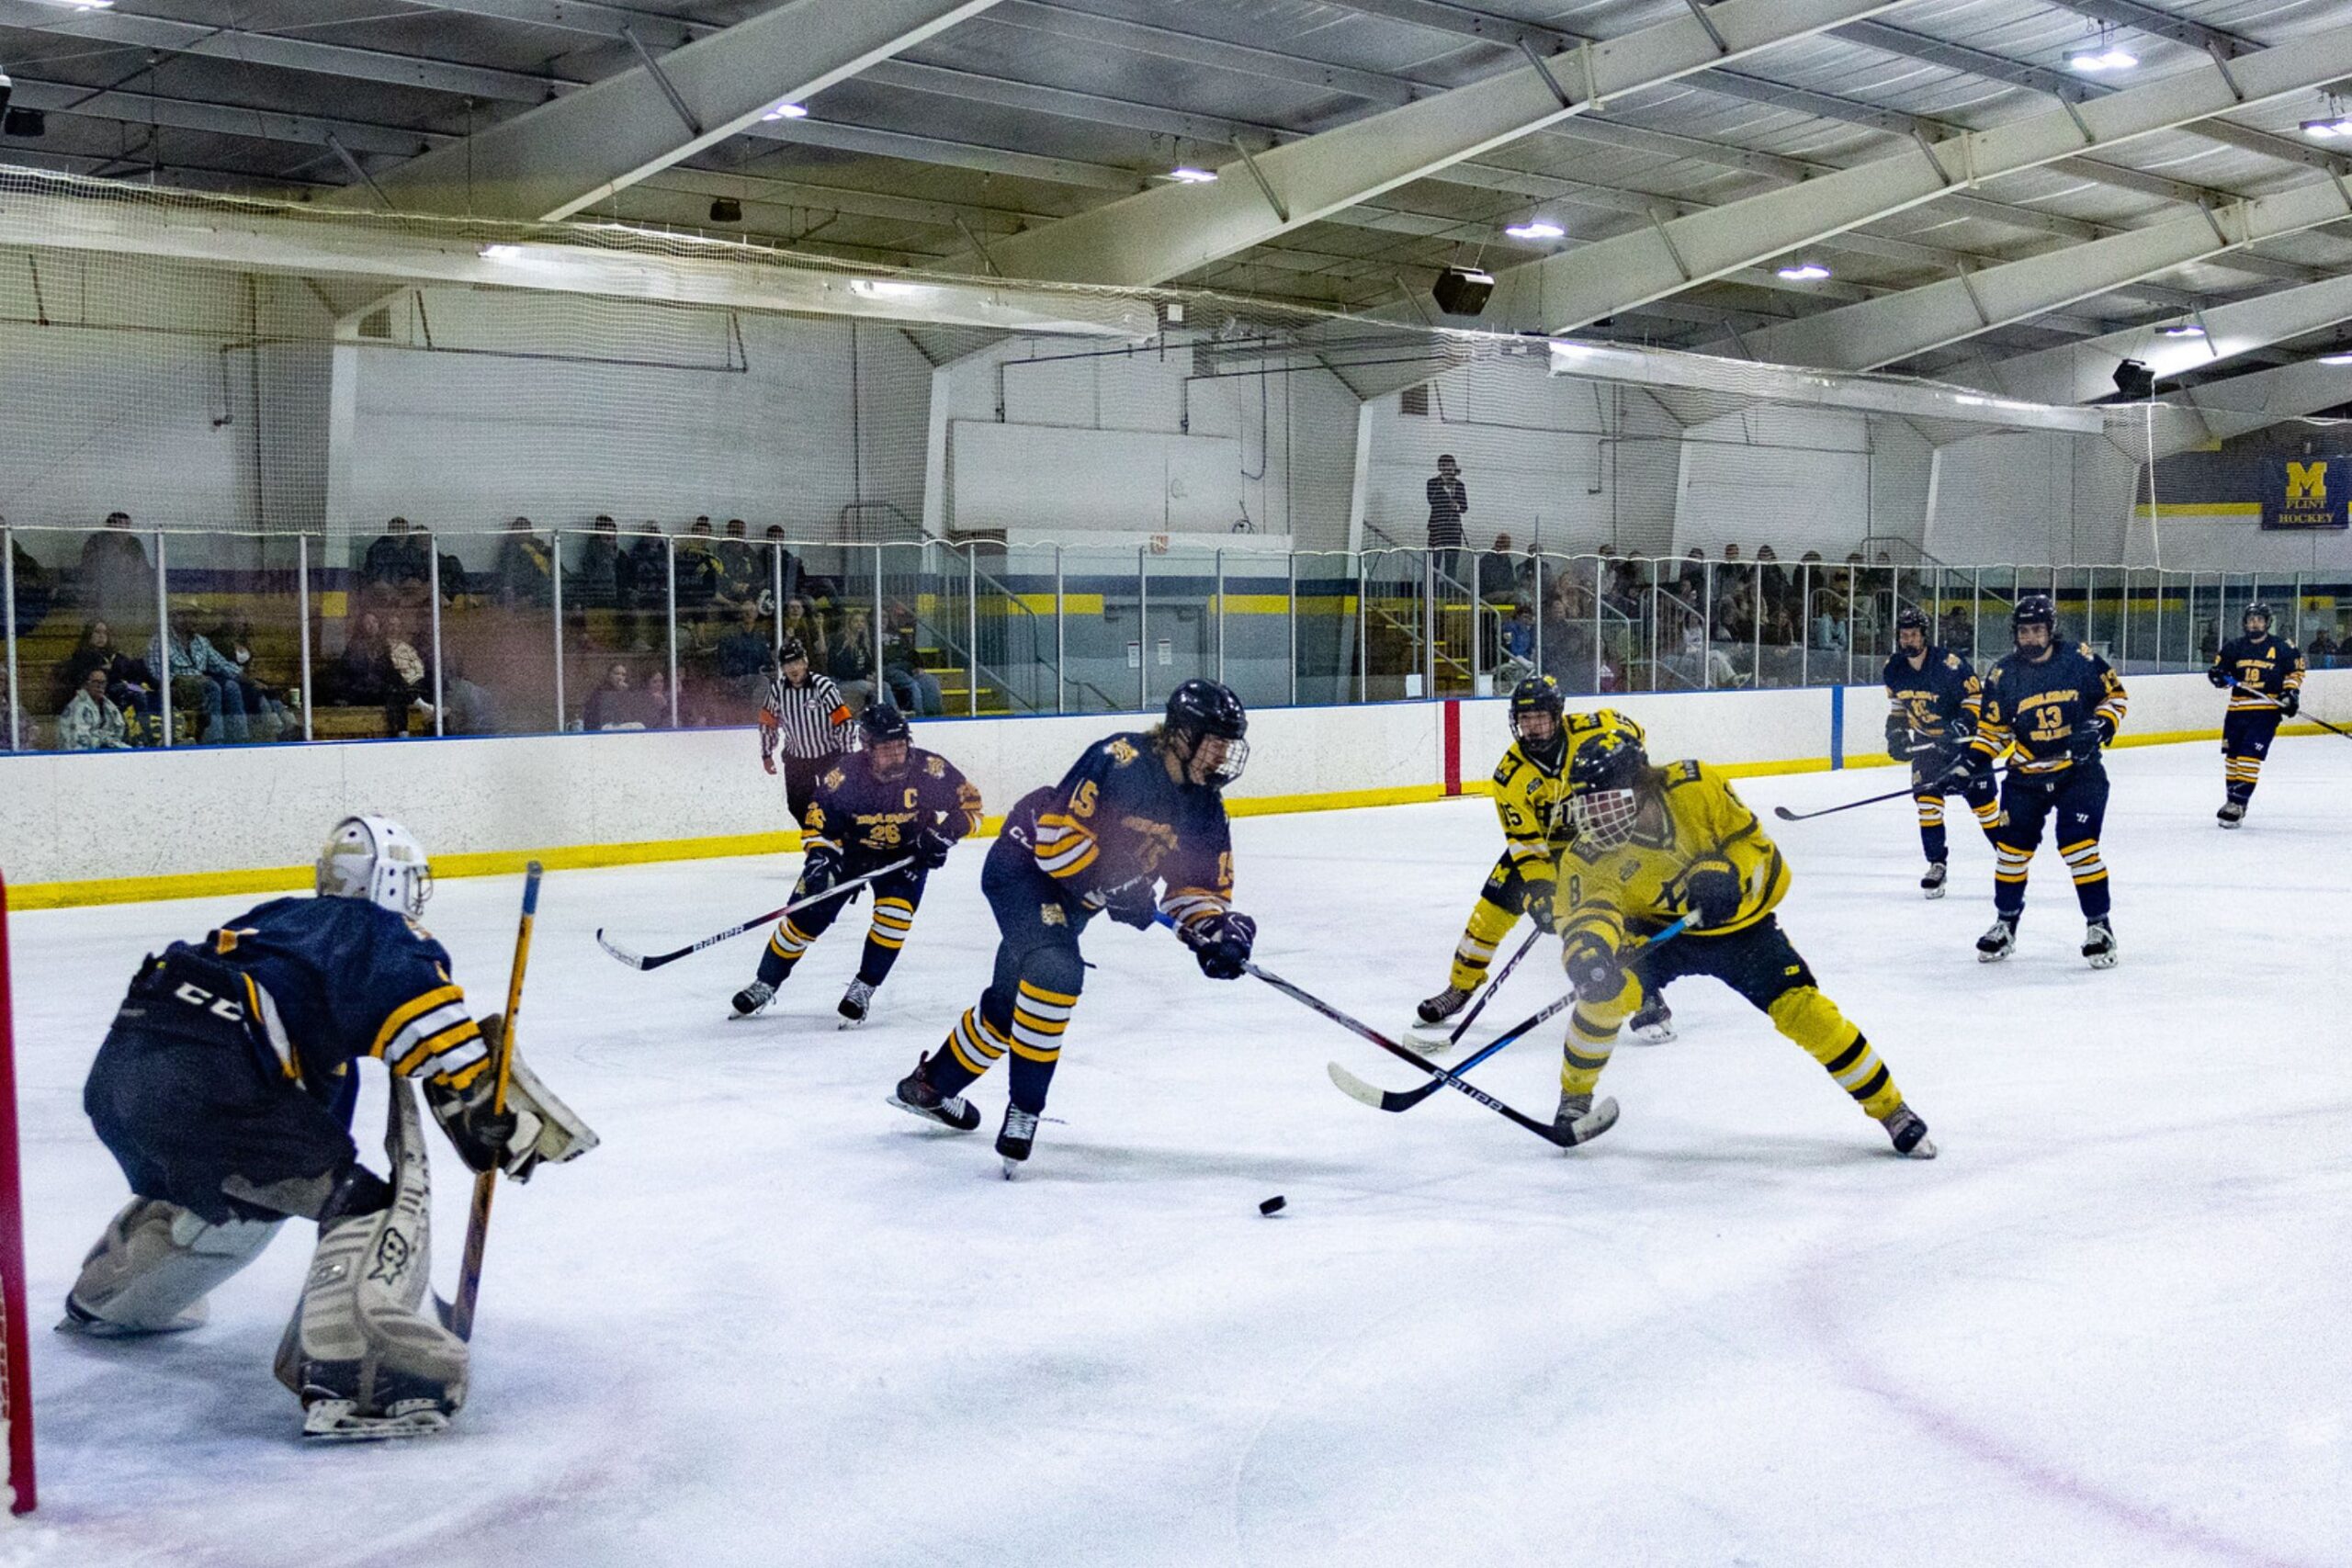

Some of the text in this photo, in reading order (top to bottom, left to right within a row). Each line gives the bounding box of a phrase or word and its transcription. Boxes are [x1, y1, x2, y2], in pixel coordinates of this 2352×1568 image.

[2287, 461, 2327, 497] M
[2287, 500, 2326, 509] FLINT
[2278, 513, 2335, 524] HOCKEY
[2266, 646, 2277, 660] A
[2036, 705, 2064, 728] 13
[1498, 753, 1519, 776] M
[904, 787, 918, 809] C
[1069, 778, 1100, 818] 15
[1499, 802, 1522, 828] 15
[869, 824, 901, 843] 26
[1570, 874, 1581, 908] 8
[693, 924, 746, 953] BAUER
[174, 981, 244, 1023] CC
